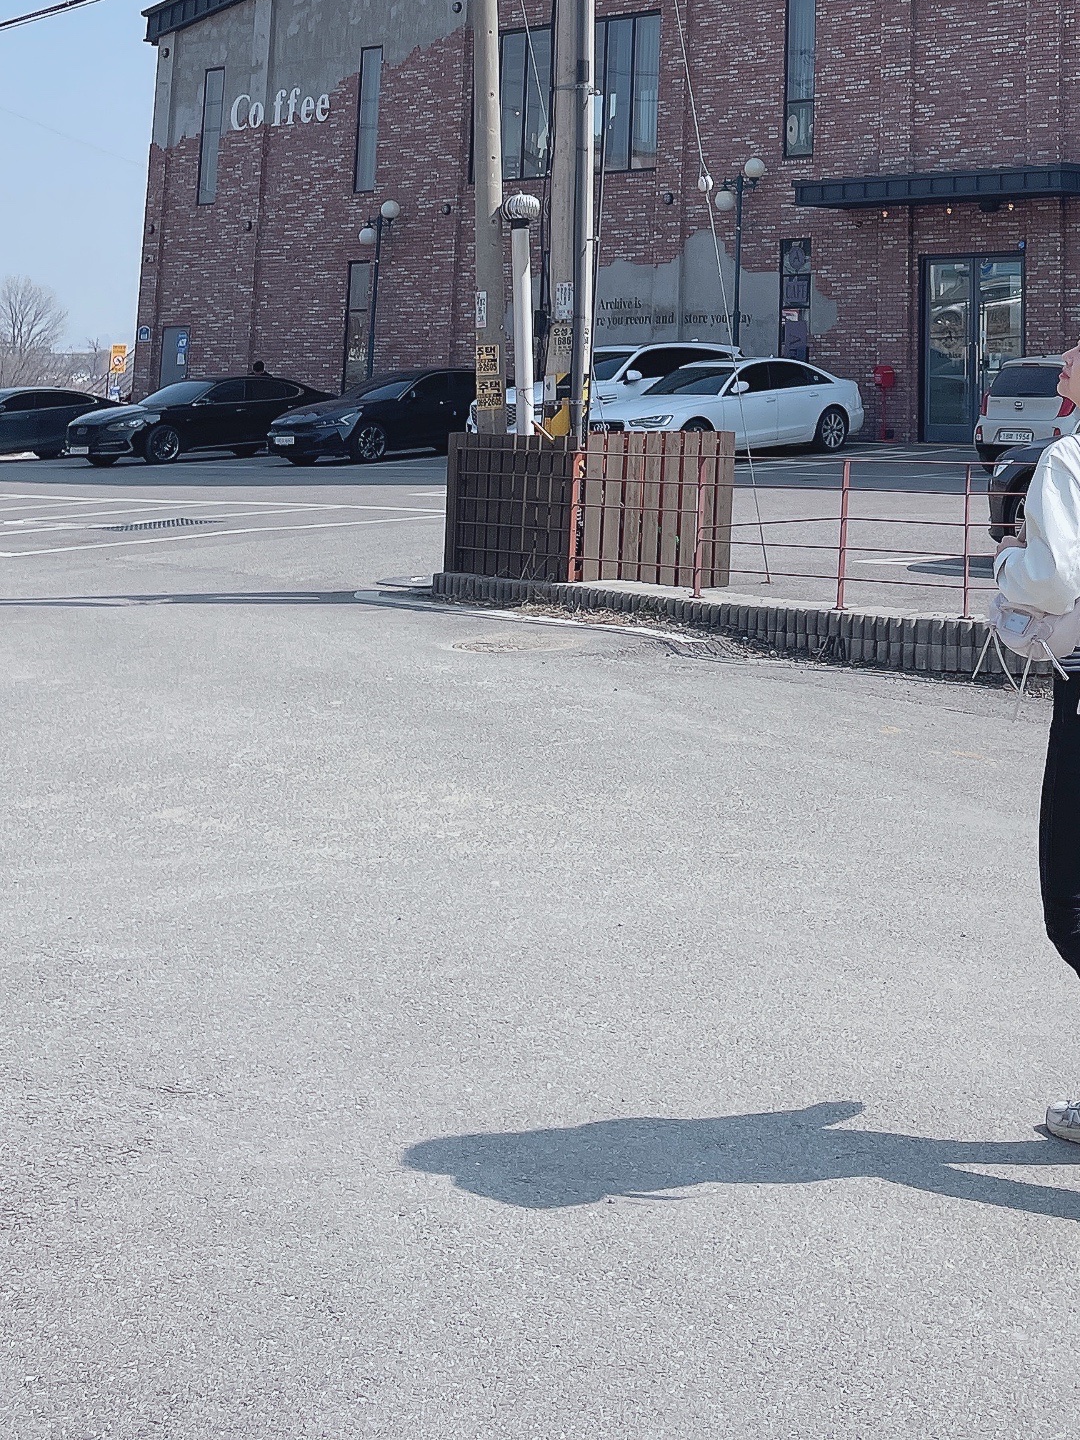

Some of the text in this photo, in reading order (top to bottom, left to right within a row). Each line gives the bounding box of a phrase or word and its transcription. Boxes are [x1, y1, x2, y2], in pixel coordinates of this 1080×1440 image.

[230, 86, 330, 132] Coffee
[599, 296, 642, 310] Archive is
[608, 317, 623, 329] you
[656, 311, 674, 324] and
[684, 314, 708, 324] store
[477, 346, 496, 358] 주택
[479, 381, 500, 393] 주택
